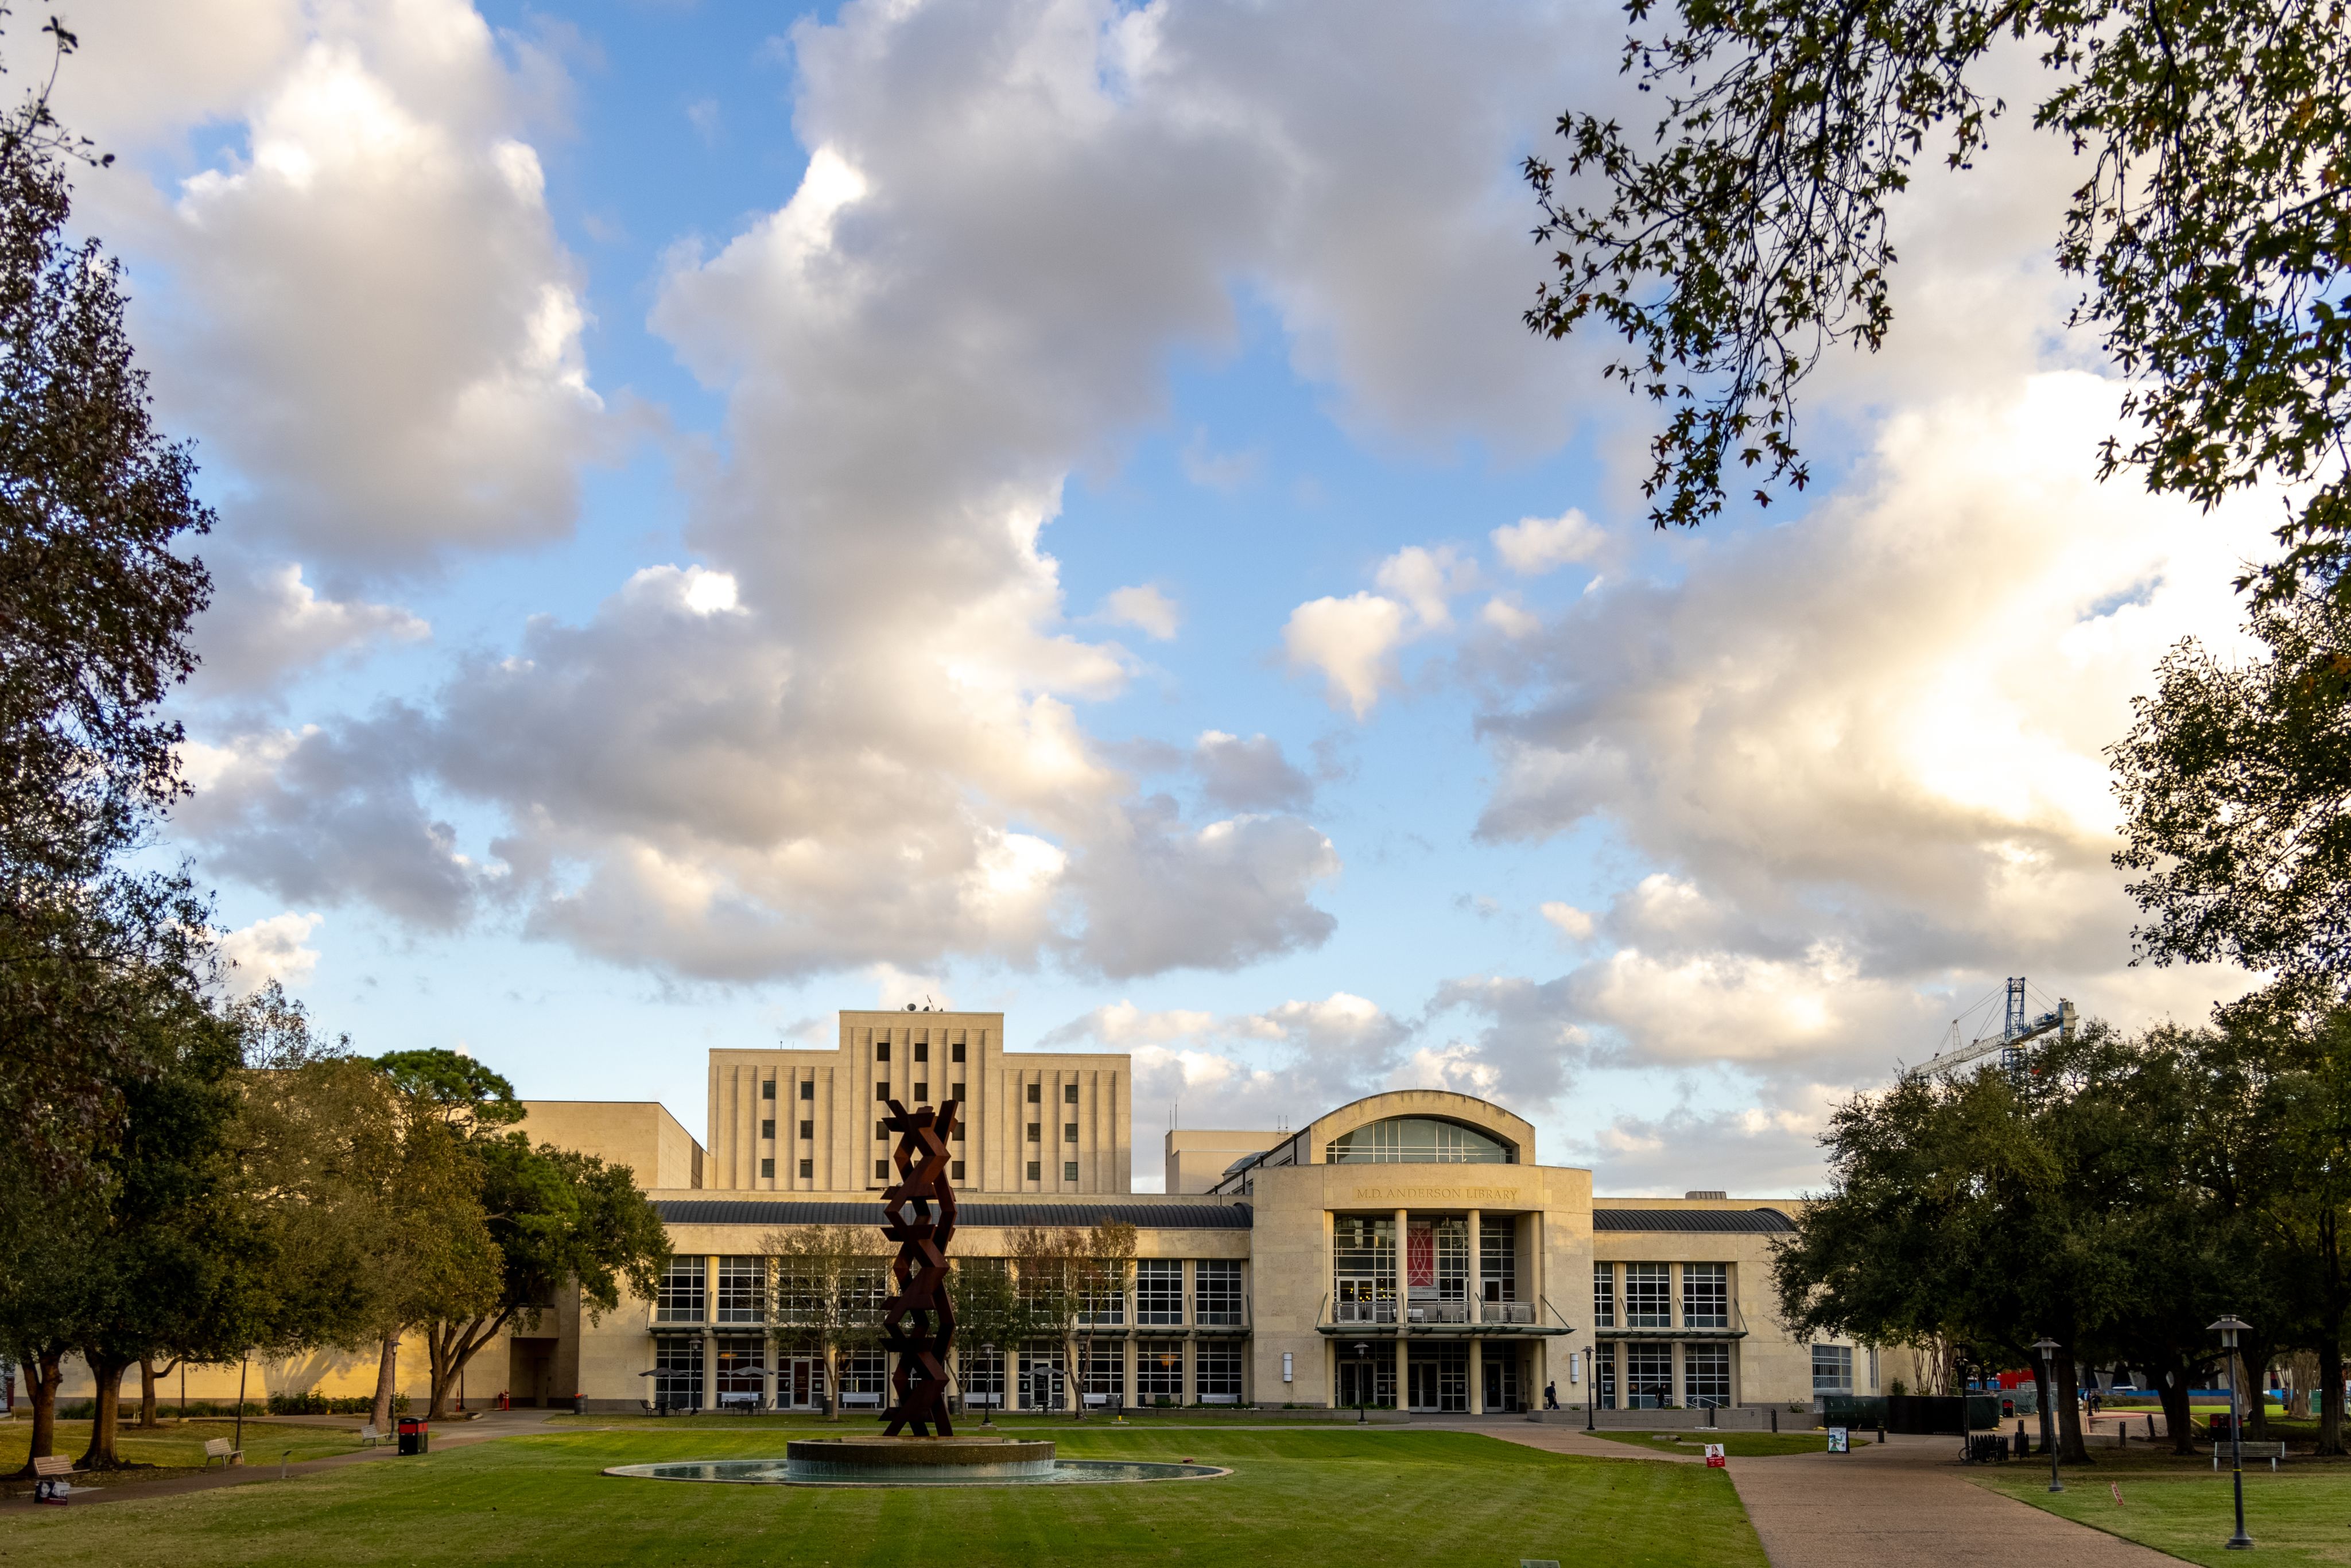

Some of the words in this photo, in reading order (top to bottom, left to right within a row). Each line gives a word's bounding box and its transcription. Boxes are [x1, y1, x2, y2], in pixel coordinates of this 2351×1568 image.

[1357, 1189, 1382, 1198] M.D.
[1387, 1189, 1460, 1198] ANDERSON
[1466, 1189, 1517, 1200] LIBRARY
